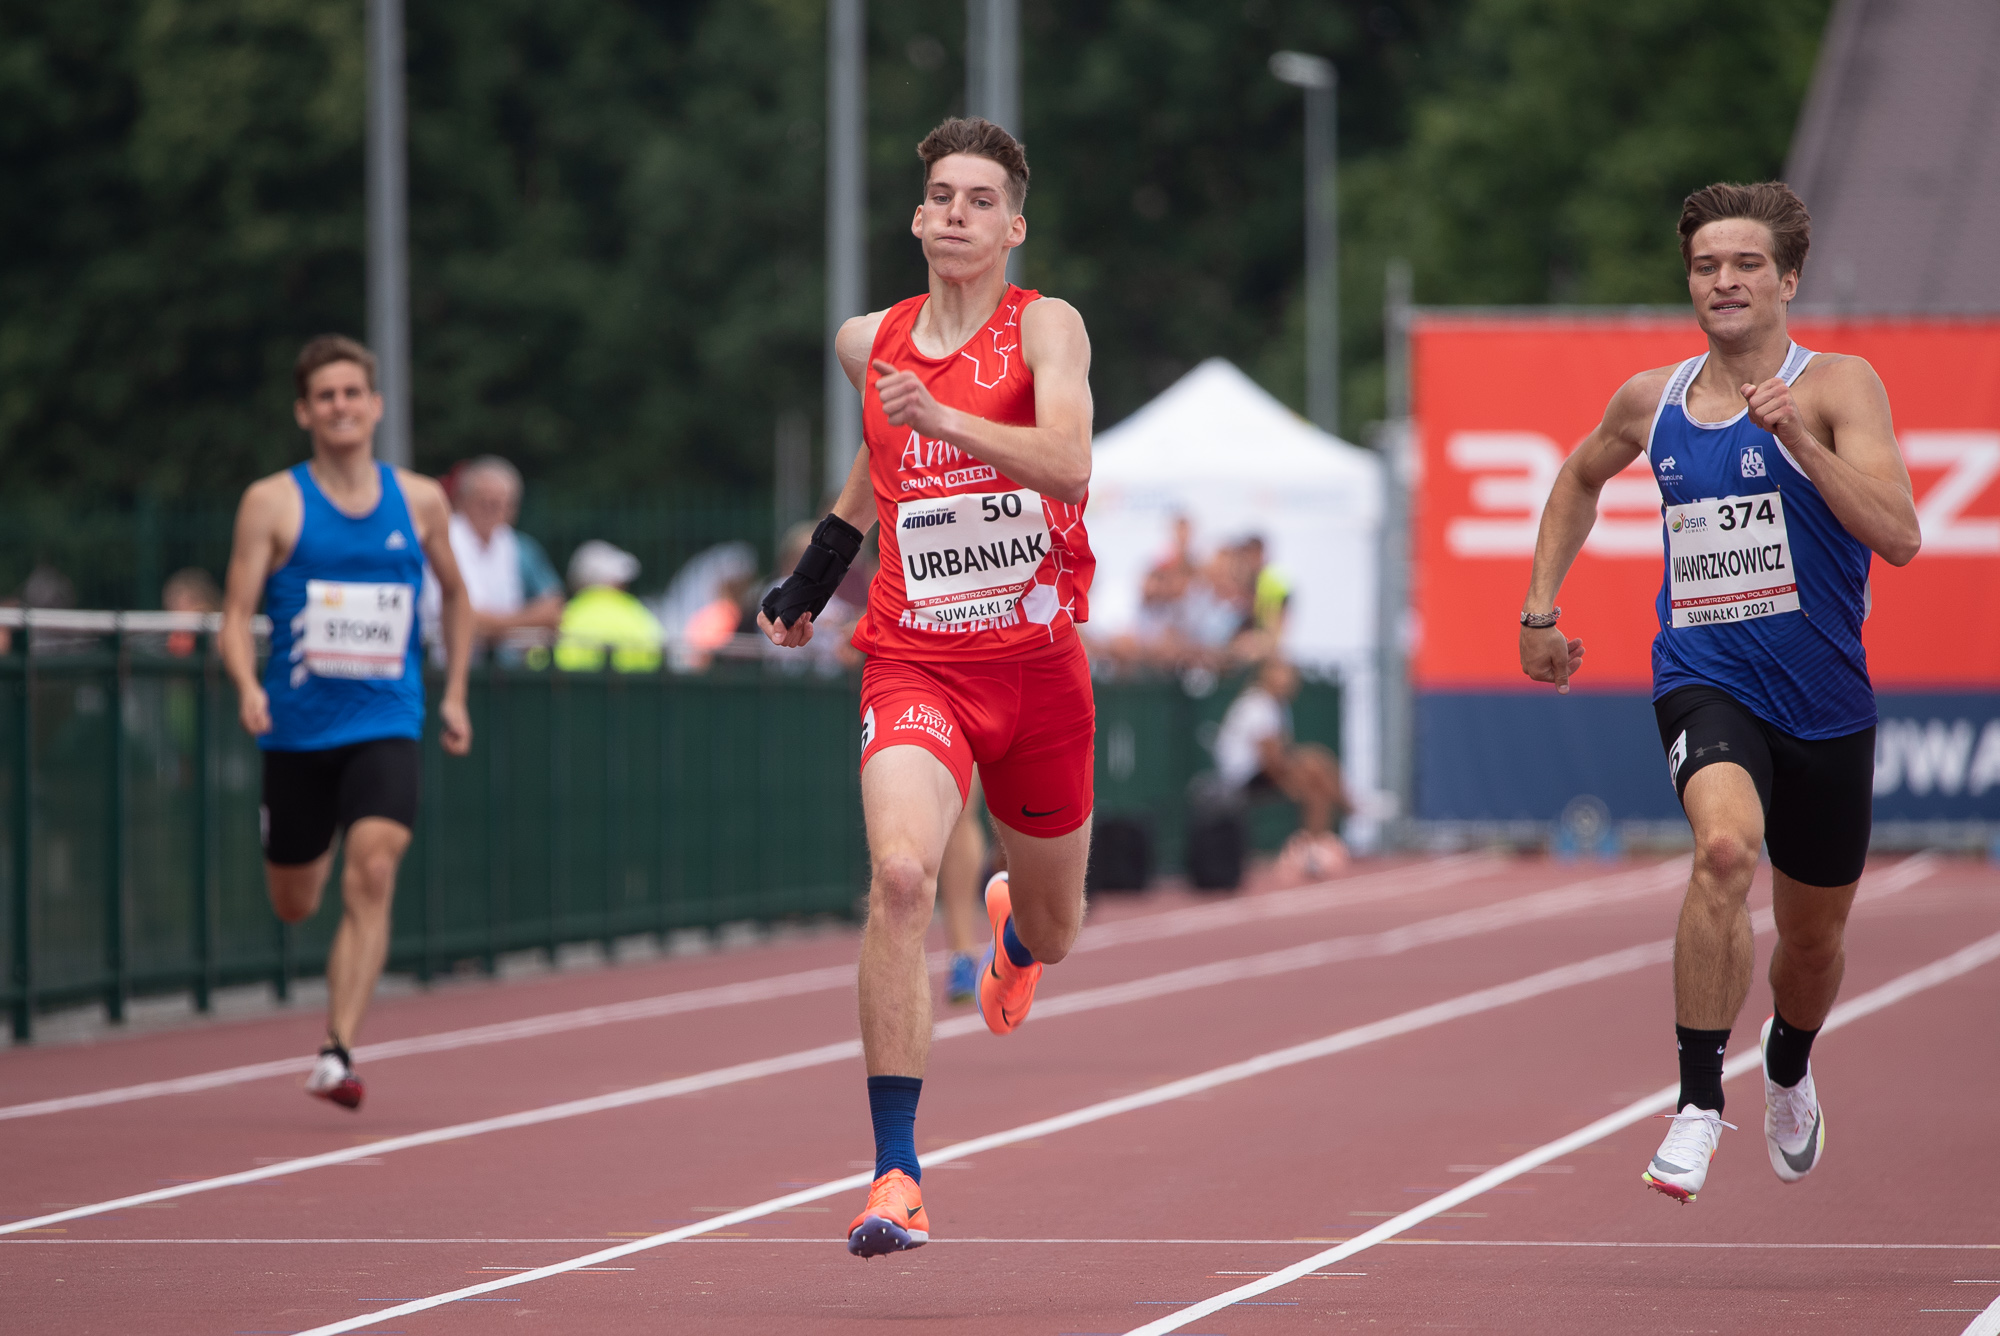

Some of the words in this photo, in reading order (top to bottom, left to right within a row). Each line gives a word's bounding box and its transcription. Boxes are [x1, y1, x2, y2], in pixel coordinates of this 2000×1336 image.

[901, 476, 943, 492] GRUPA
[947, 466, 993, 485] ORLEN
[902, 511, 957, 530] 4MOVE
[981, 493, 1022, 522] 50
[1717, 499, 1776, 531] 374
[908, 532, 1046, 582] URBANIAK
[1672, 544, 1786, 583] WAWRZKOWICZ
[929, 596, 950, 606] PZLA
[951, 586, 1008, 601] MISTRZOSTWA
[1698, 594, 1747, 605] MISTRZOSTWA
[1747, 588, 1774, 598] POLSKI
[1775, 586, 1792, 594] U23
[935, 601, 1001, 622] SUWAŁKI
[1687, 607, 1739, 623] SUWAŁKI
[1743, 601, 1775, 617] 2021
[895, 704, 953, 738] Anwil
